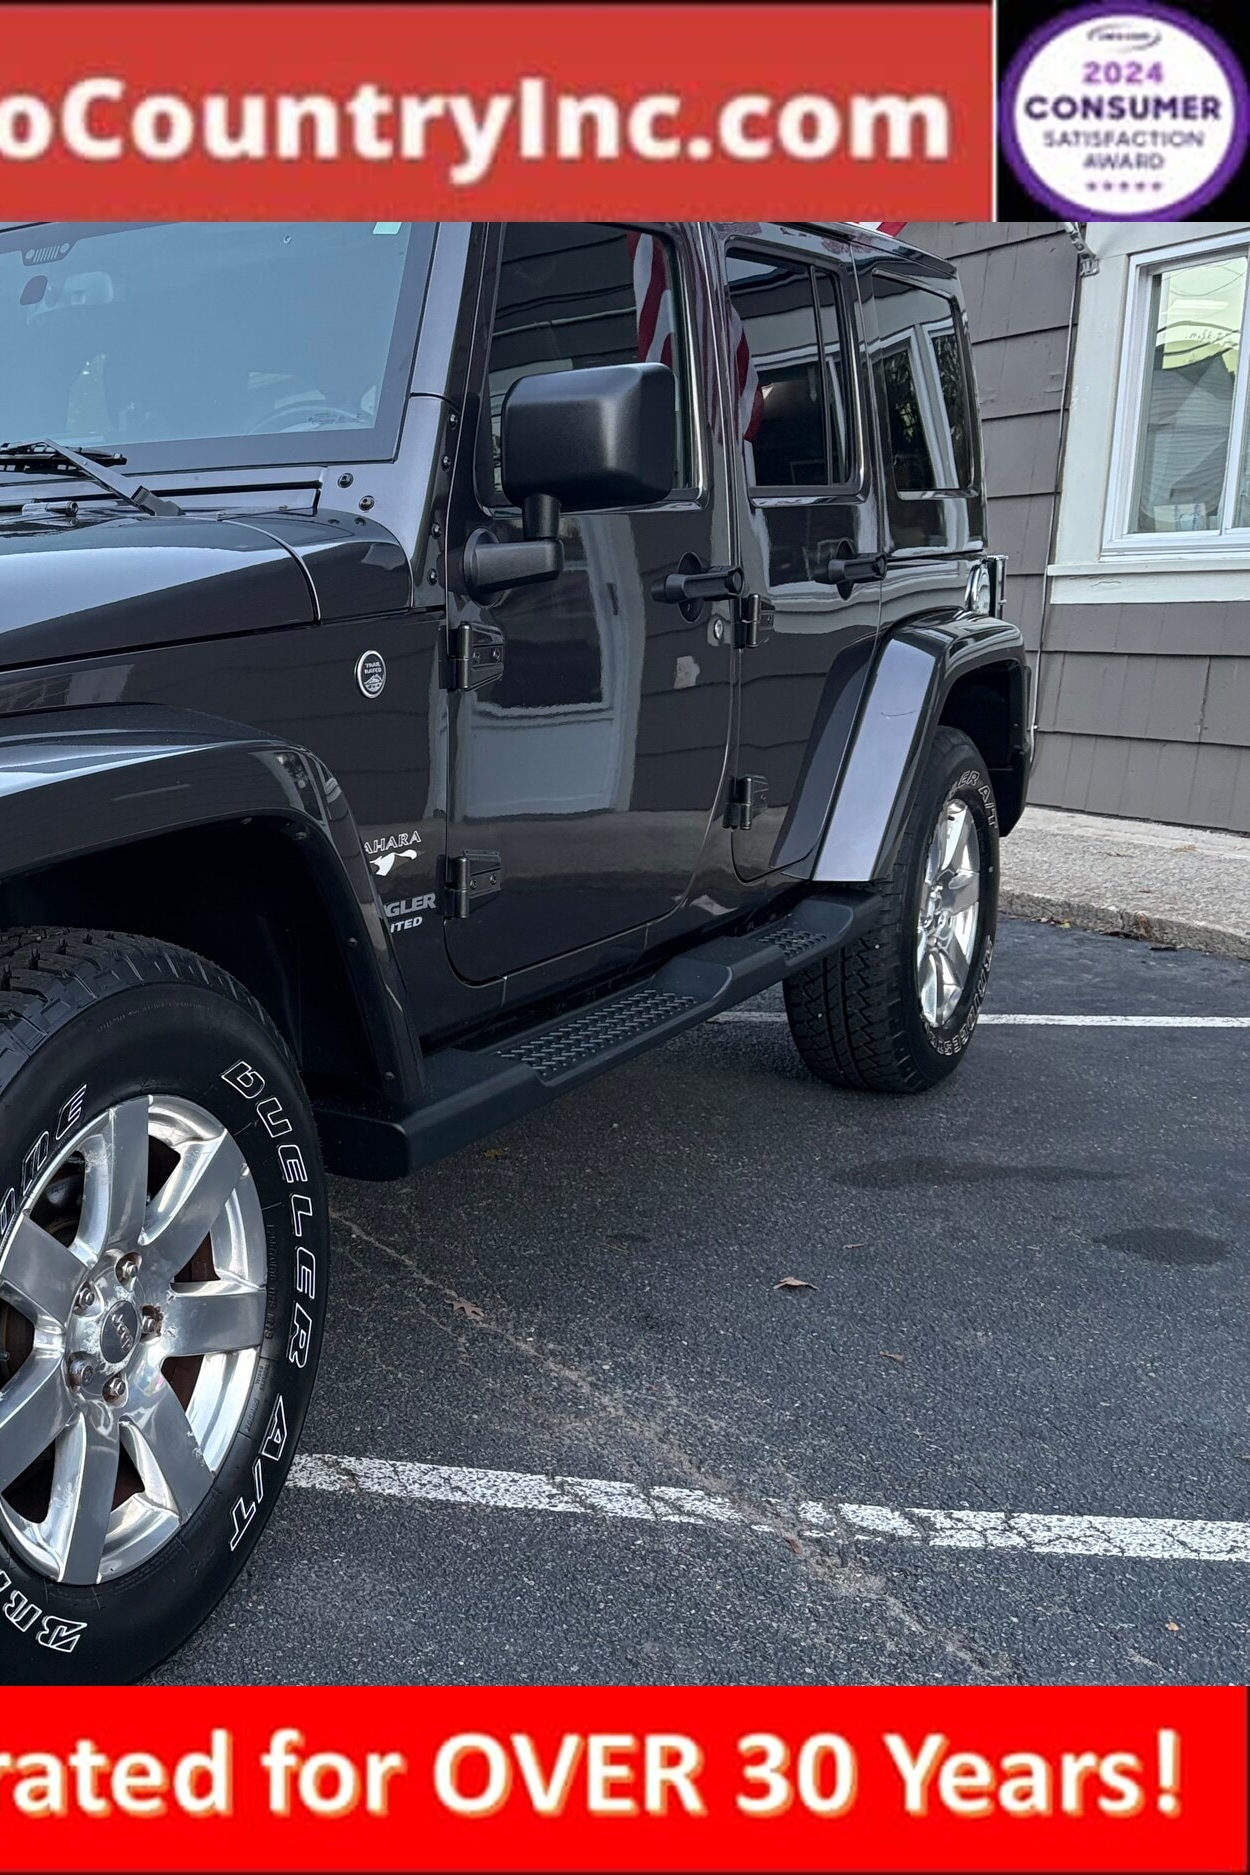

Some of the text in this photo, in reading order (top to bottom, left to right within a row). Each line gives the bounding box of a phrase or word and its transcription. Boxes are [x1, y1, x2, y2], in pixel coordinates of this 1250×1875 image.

[364, 661, 381, 669] TRAIL
[364, 830, 422, 855] AHARA
[384, 892, 437, 918] GLER
[221, 1058, 317, 1552] DUELER A/T
